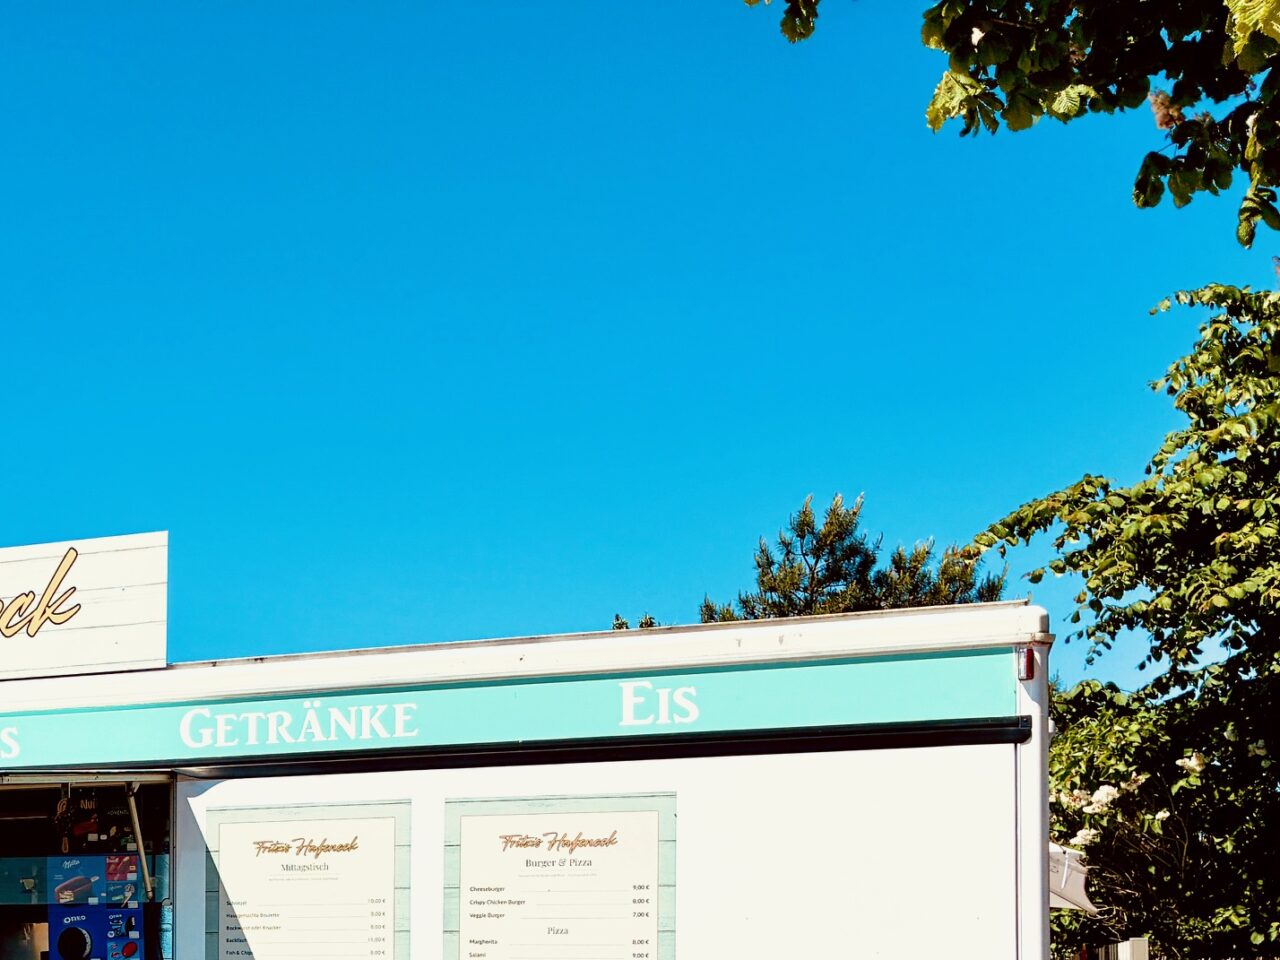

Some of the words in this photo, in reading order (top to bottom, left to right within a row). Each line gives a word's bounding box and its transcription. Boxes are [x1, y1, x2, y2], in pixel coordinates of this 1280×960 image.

[620, 680, 700, 727] EIS
[180, 701, 420, 749] GETRÄNKE
[291, 836, 359, 859] Hafeneck
[542, 830, 618, 855] Hafeneck
[281, 862, 329, 872] Mittagstisch
[525, 859, 556, 868] Burger
[558, 859, 567, 867] &
[569, 858, 593, 867] Pizza
[63, 915, 86, 924] OREO
[547, 926, 569, 935] Pizza
